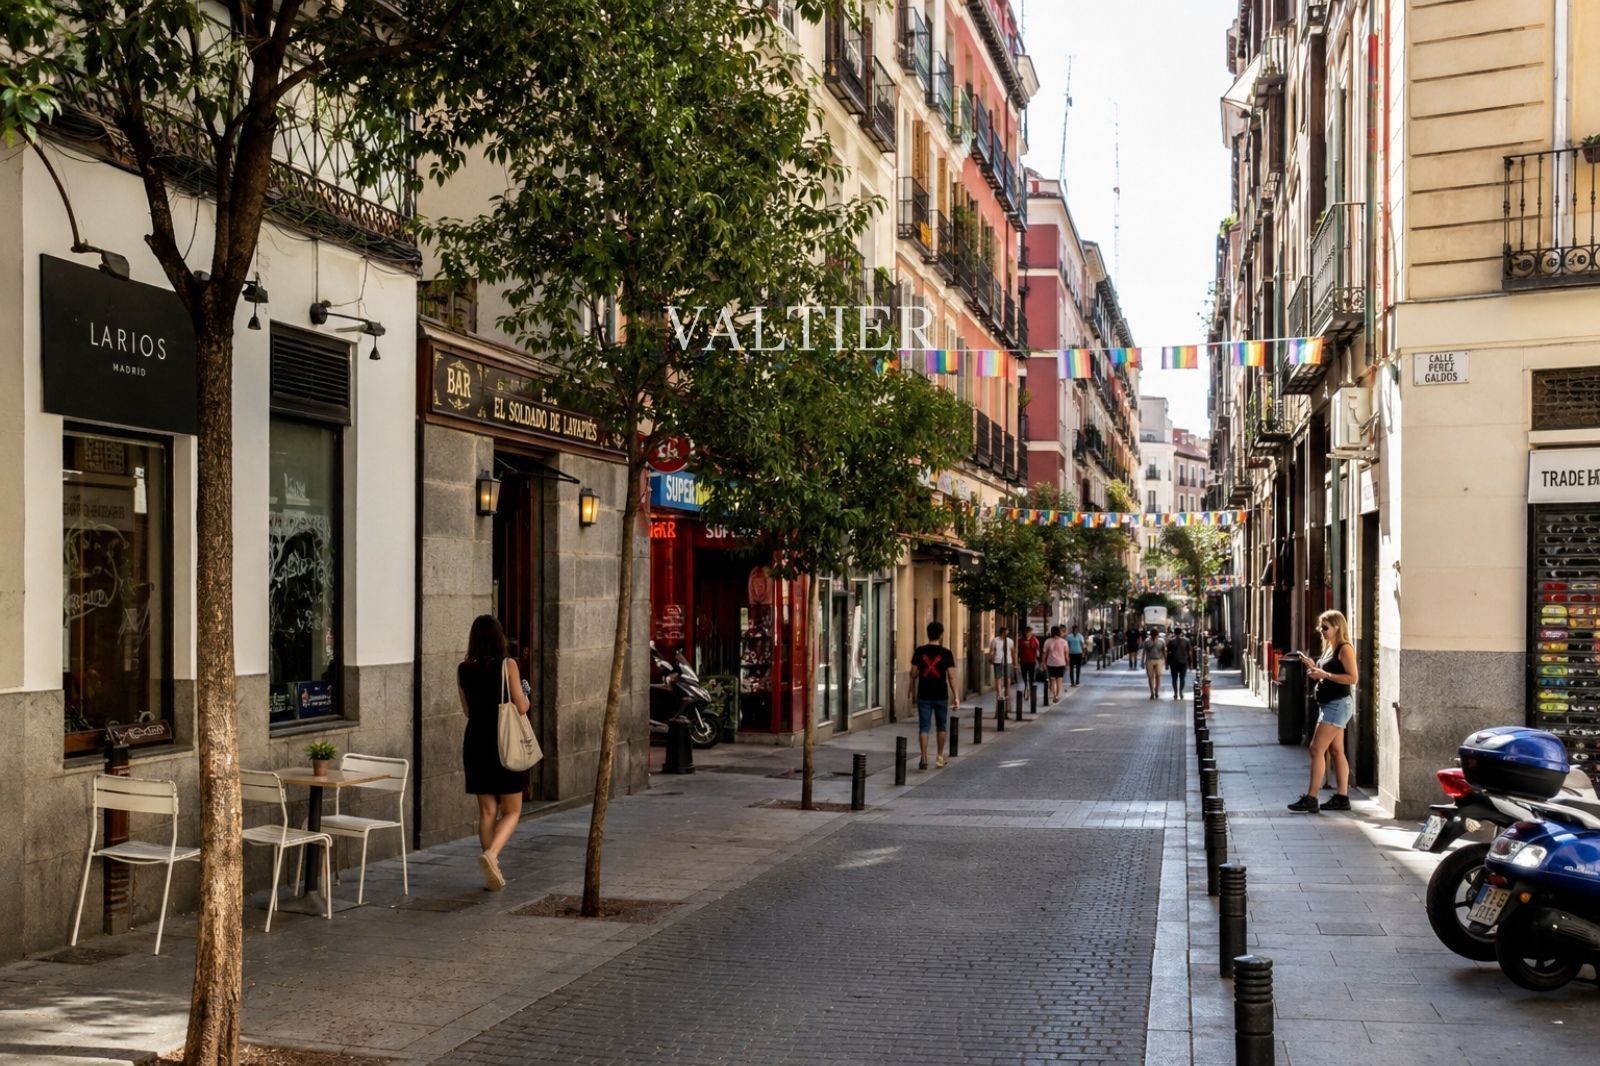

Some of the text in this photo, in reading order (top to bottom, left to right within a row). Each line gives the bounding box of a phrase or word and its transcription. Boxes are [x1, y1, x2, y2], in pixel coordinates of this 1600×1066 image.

[90, 322, 166, 360] LARIOS
[1429, 353, 1454, 363] CALLE
[112, 363, 146, 376] MADRID
[1425, 372, 1458, 383] GALDOS
[447, 367, 472, 398] BAR
[494, 397, 506, 420] EL
[508, 401, 548, 430] SOLDADO
[550, 411, 560, 433] DE
[1541, 470, 1585, 487] TRADE
